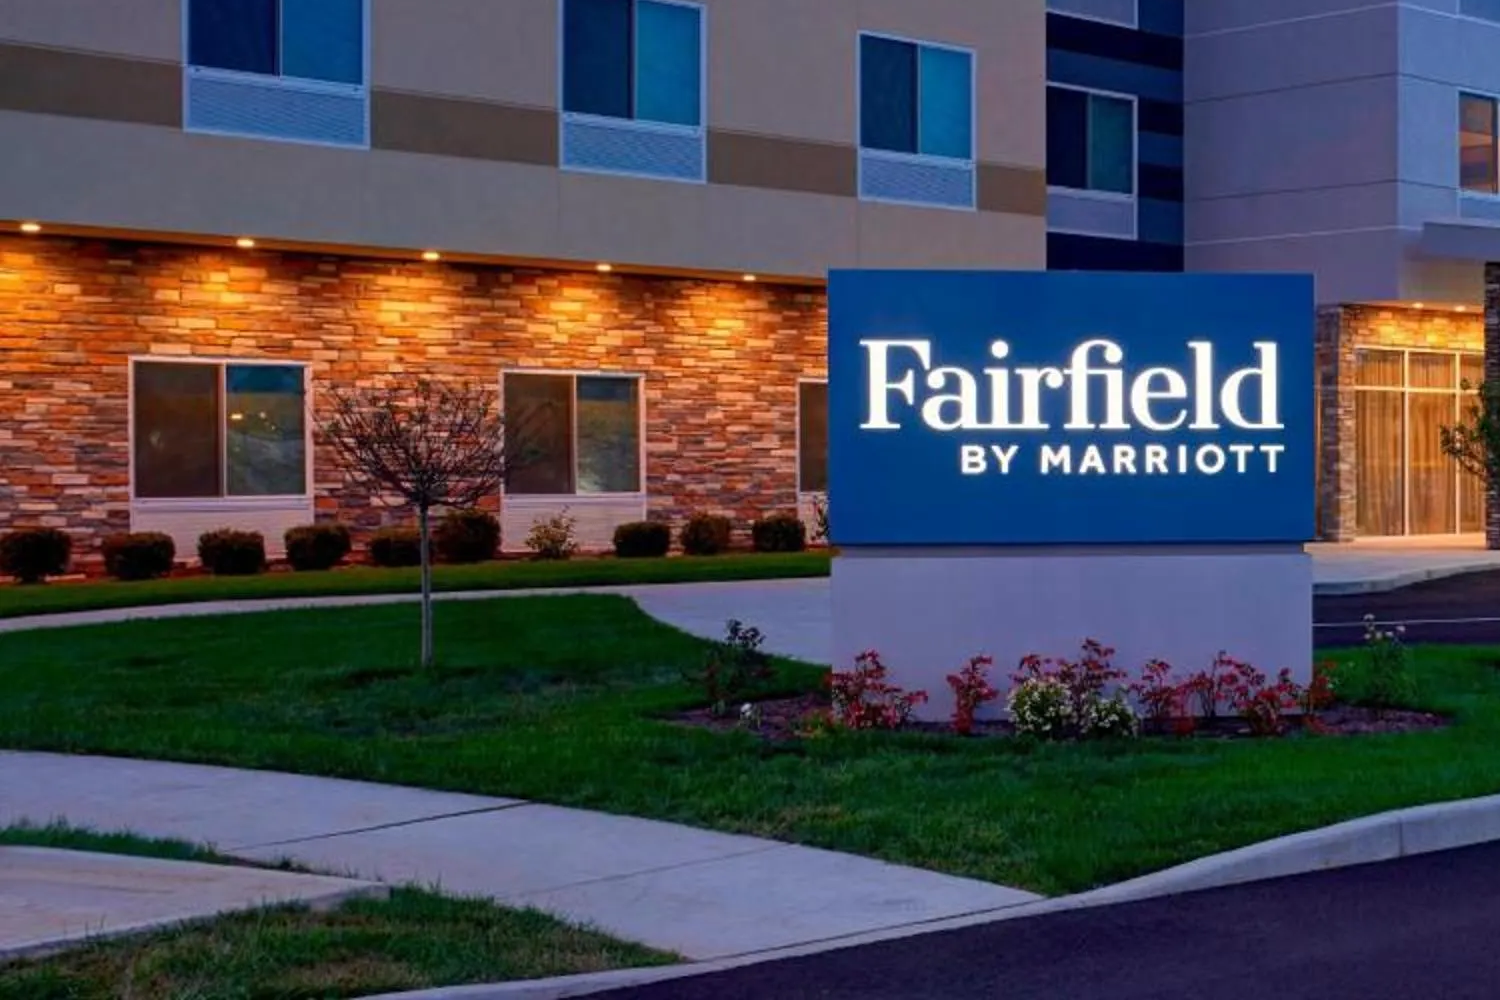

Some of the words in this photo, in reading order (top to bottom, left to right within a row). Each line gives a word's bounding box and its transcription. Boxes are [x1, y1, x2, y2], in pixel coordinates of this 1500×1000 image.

[858, 338, 1286, 431] Fairfield
[960, 443, 1019, 475] BY
[1039, 443, 1286, 475] MARRIOTT
